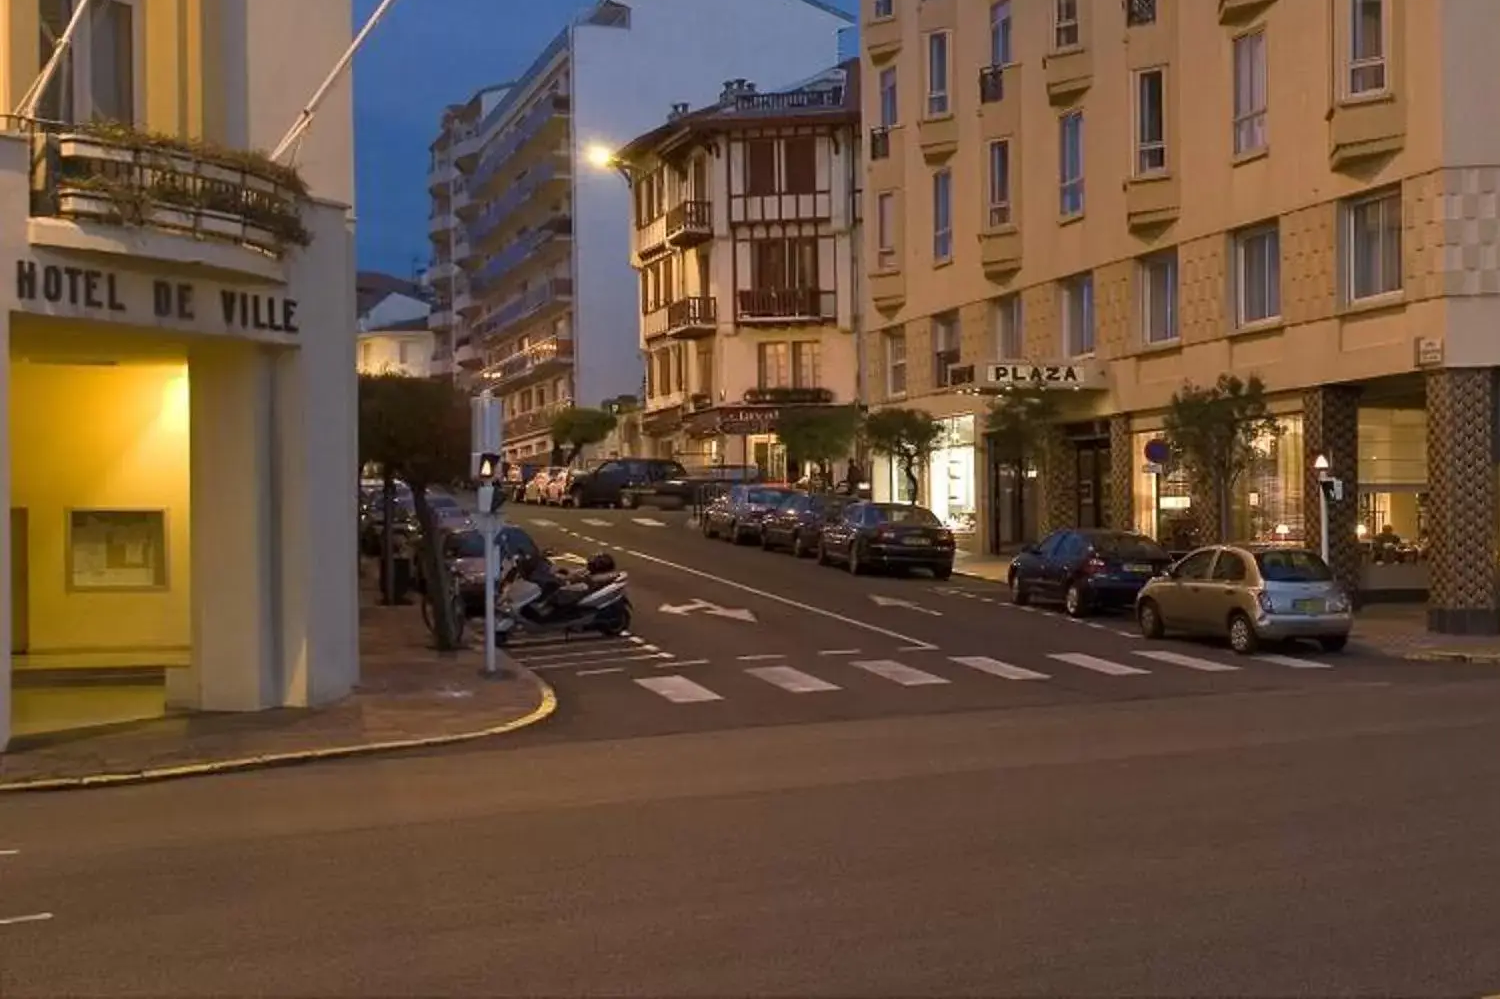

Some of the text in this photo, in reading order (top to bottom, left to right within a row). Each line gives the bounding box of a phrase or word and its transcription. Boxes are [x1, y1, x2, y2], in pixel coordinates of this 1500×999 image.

[16, 259, 299, 332] HOTEL DE VILLE
[995, 366, 1077, 381] PLAZA
